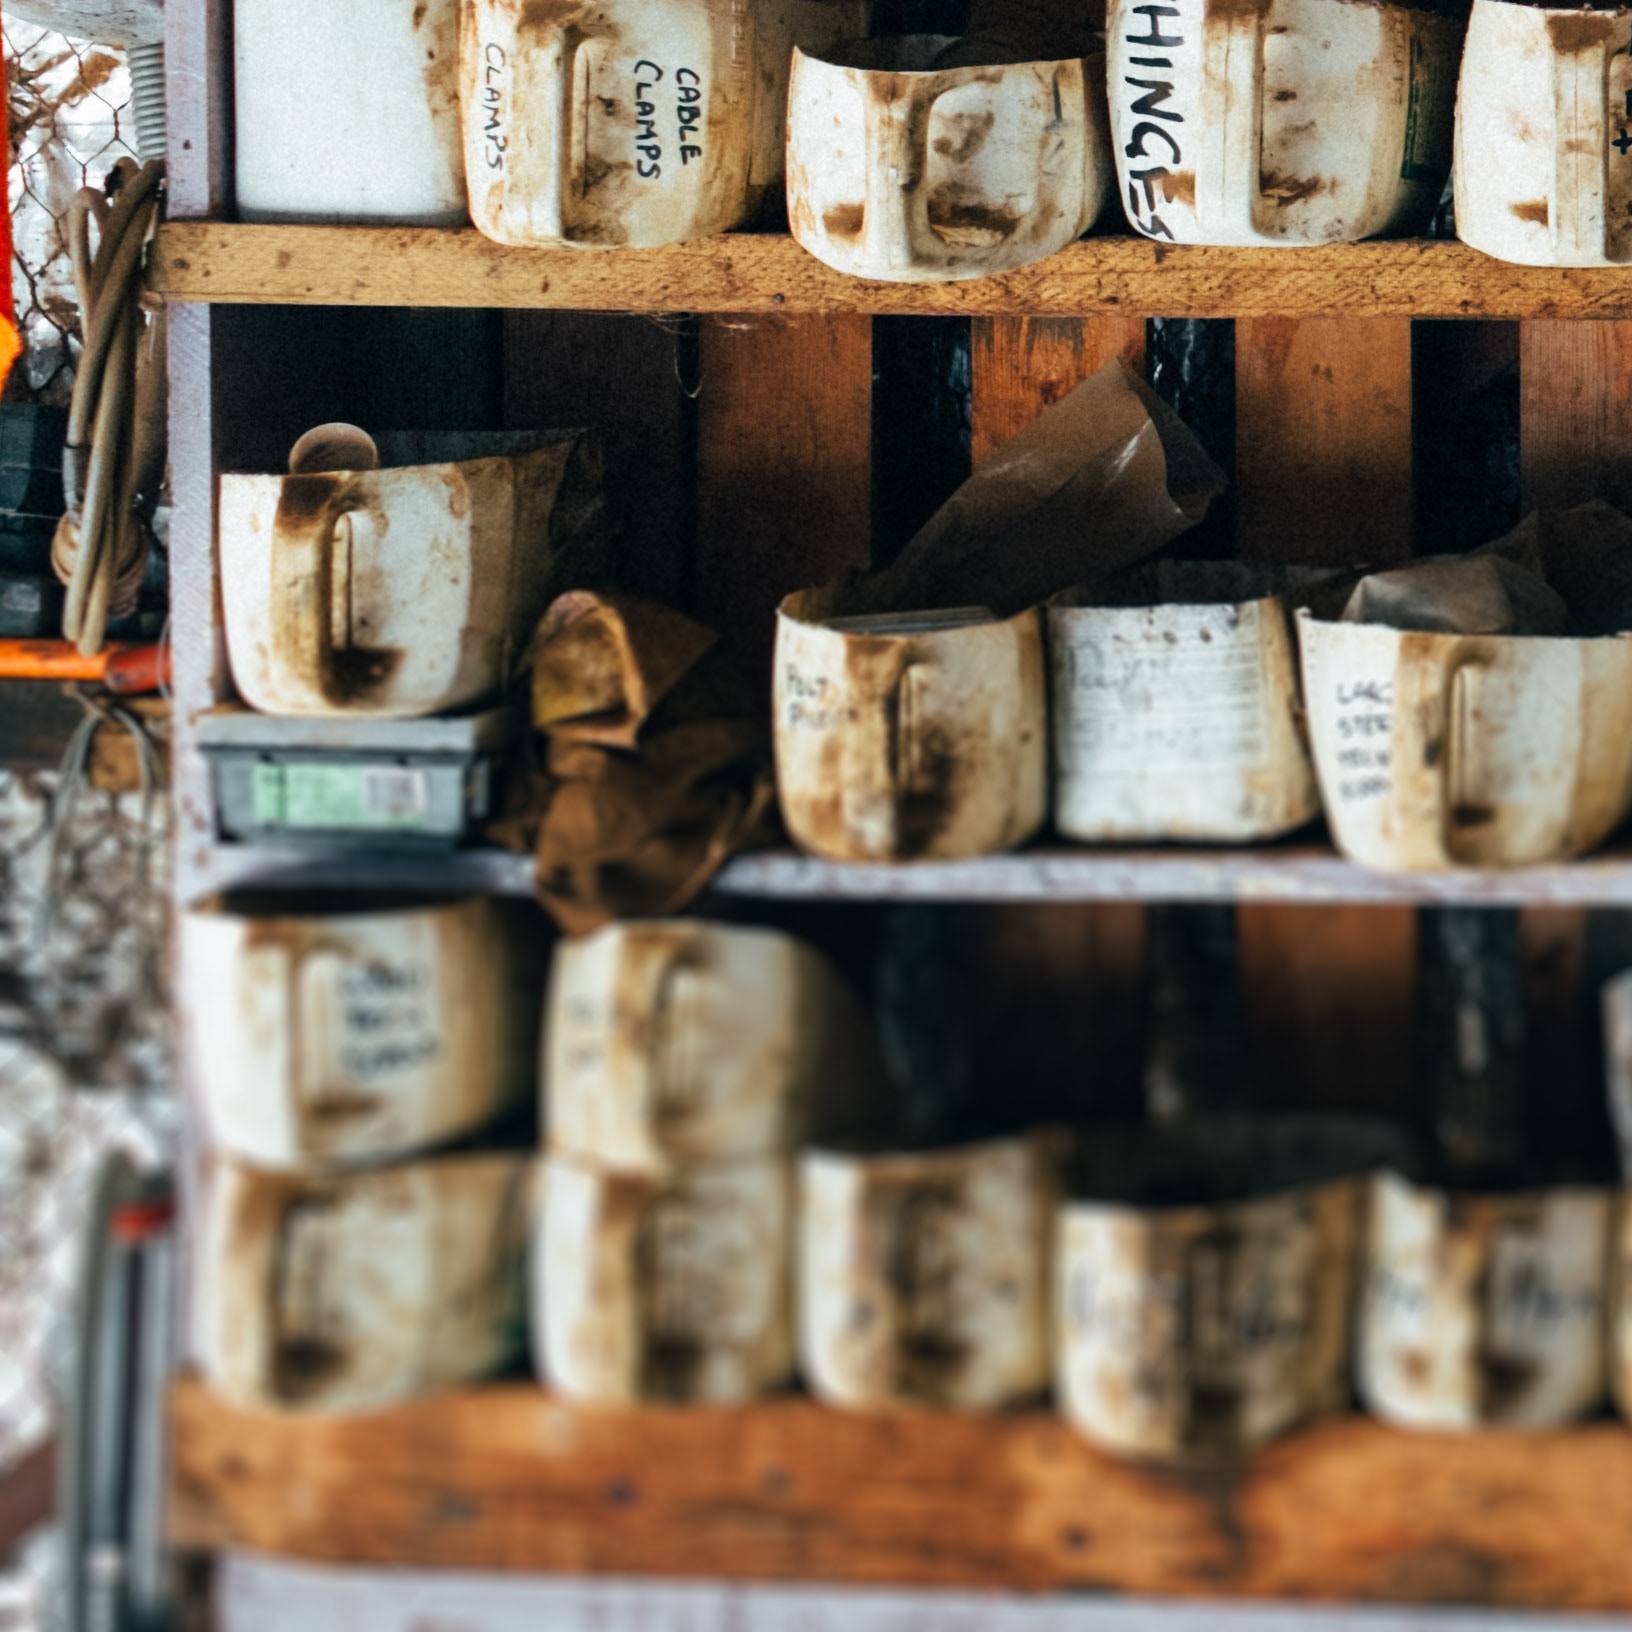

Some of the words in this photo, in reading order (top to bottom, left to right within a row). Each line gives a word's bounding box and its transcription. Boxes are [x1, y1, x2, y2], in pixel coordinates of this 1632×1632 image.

[484, 43, 509, 172] CLAMPS
[634, 60, 661, 180] CLAMPS
[676, 67, 704, 166] CABLE
[1124, 5, 1187, 241] HINGES
